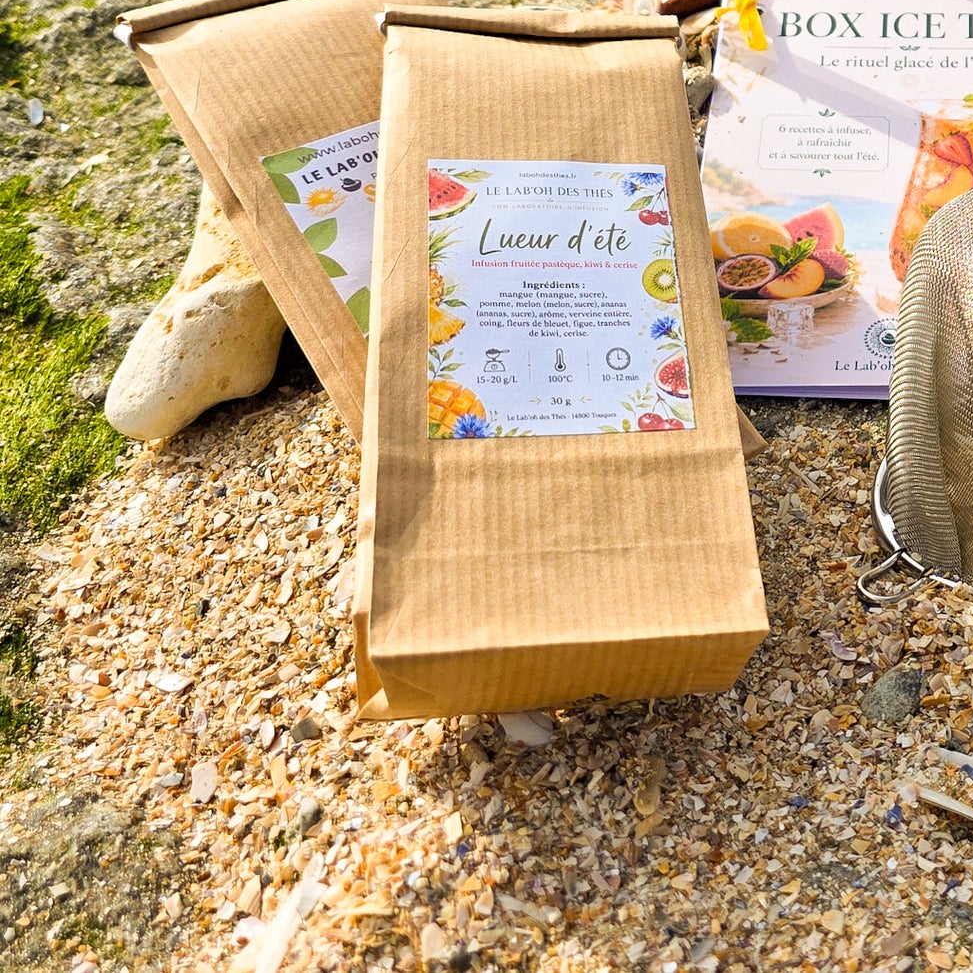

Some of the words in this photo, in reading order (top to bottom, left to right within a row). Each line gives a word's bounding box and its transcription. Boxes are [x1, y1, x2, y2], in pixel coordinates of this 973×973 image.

[777, 11, 865, 39] BOX
[880, 11, 946, 39] ICE
[820, 55, 840, 67] Le
[845, 55, 889, 68] rituel
[894, 55, 934, 71] glacé
[939, 56, 961, 69] de
[778, 124, 786, 133] 6
[828, 126, 833, 134] à
[836, 125, 872, 135] infuser,
[297, 131, 380, 164] www.laboh
[834, 152, 853, 160] tout
[857, 152, 879, 161] l'été.
[302, 170, 323, 184] LE
[486, 187, 501, 196] LE
[506, 186, 553, 196] LAB'OH
[557, 187, 580, 196] DES
[583, 187, 614, 198] THÉS
[479, 218, 559, 256] Lueur
[568, 219, 632, 257] d'été
[471, 259, 508, 268] Infusion
[510, 259, 540, 268] fruitée
[542, 260, 583, 269] pastèque,
[584, 260, 603, 268] kiwi
[523, 281, 580, 290] Ingrédients
[536, 291, 577, 300] (mangue,
[579, 291, 608, 299] sucre),
[543, 301, 572, 309] (melon,
[574, 301, 599, 309] sucre),
[476, 310, 509, 318] (ananas,
[511, 310, 538, 318] sucre),
[479, 320, 504, 328] coing,
[544, 320, 571, 328] bleuet,
[573, 320, 596, 328] figue,
[835, 360, 850, 370] Le
[503, 376, 518, 384] g/L
